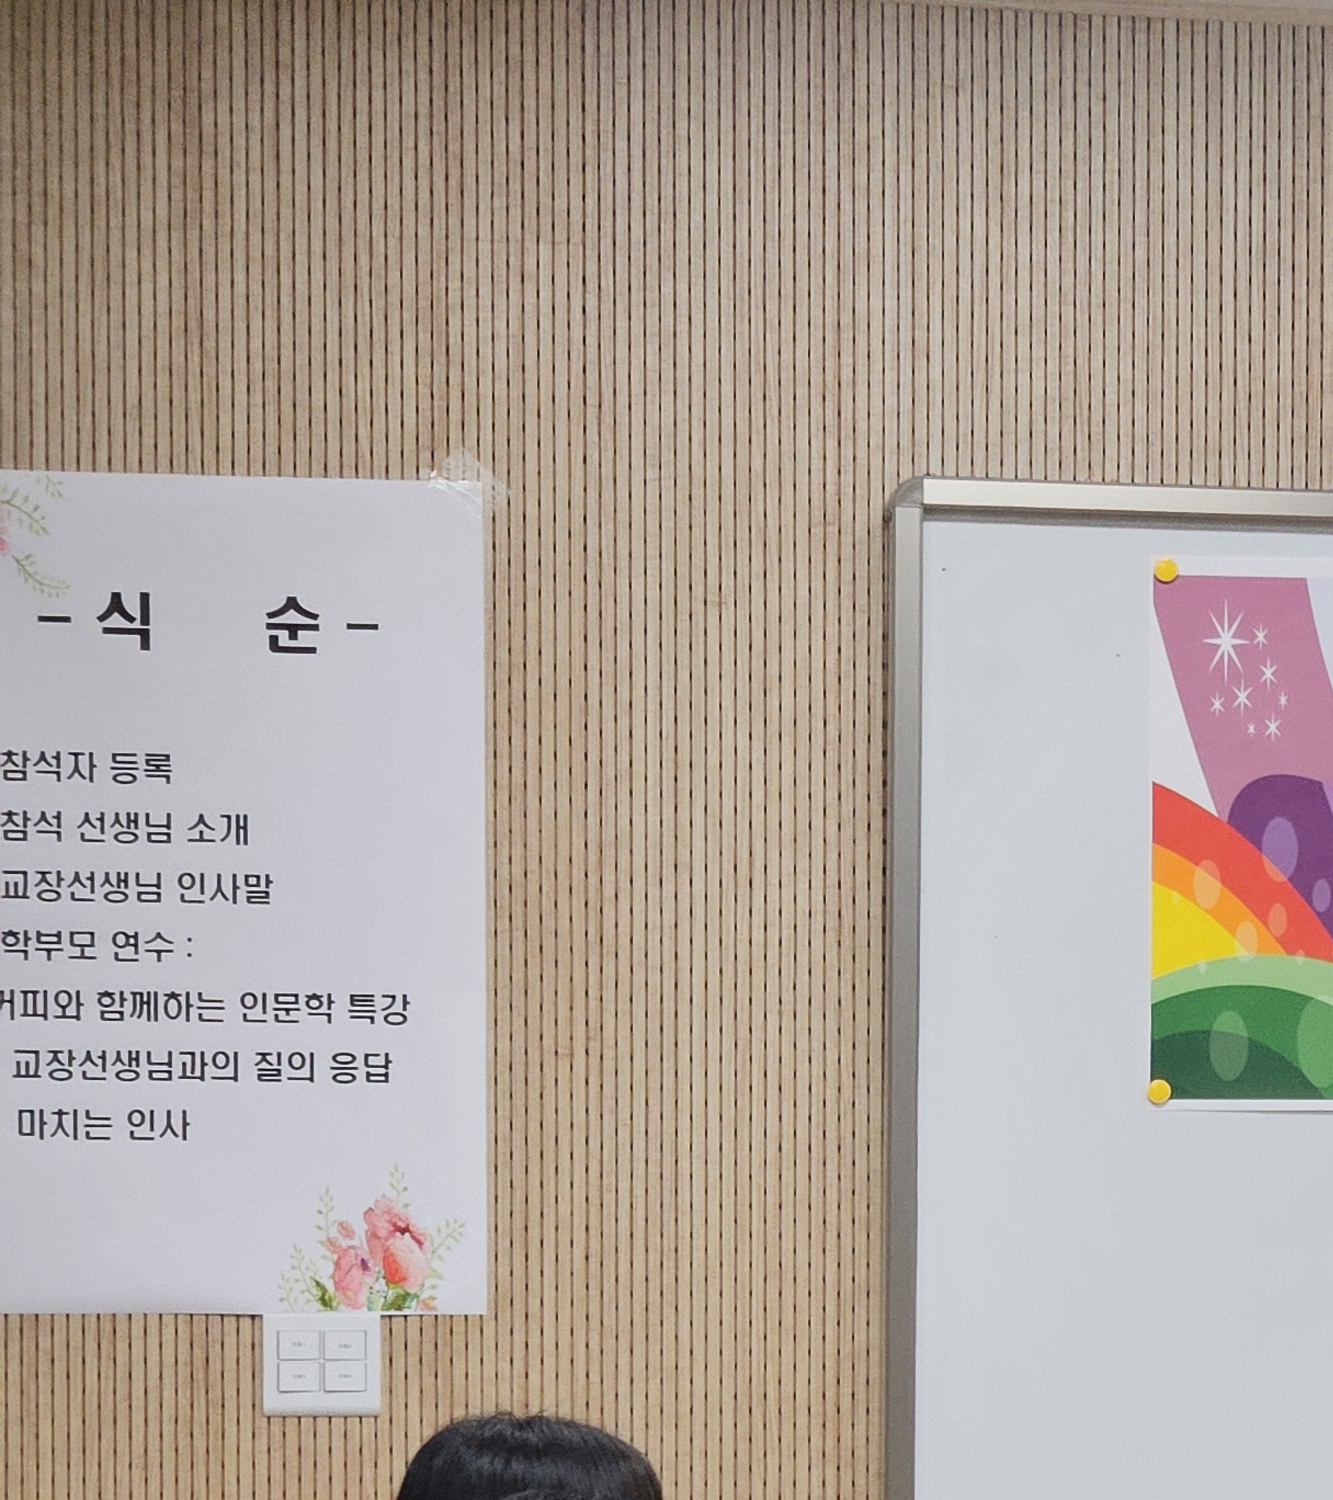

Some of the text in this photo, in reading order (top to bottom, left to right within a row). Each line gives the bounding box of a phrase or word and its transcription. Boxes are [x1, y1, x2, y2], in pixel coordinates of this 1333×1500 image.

[0, 749, 173, 785] 참석자 등록
[0, 809, 249, 847] 참석 선생님 소개
[0, 869, 274, 906] 교장선생님 인사말
[0, 928, 98, 962] 학부모
[111, 930, 175, 964] 연수
[96, 989, 226, 1023] 함께하는
[239, 991, 336, 1025] 인문학
[347, 993, 411, 1026] 특강
[11, 1048, 394, 1085] 교장선생님과의 질의 응답
[17, 1107, 191, 1142] 마치는 인사
